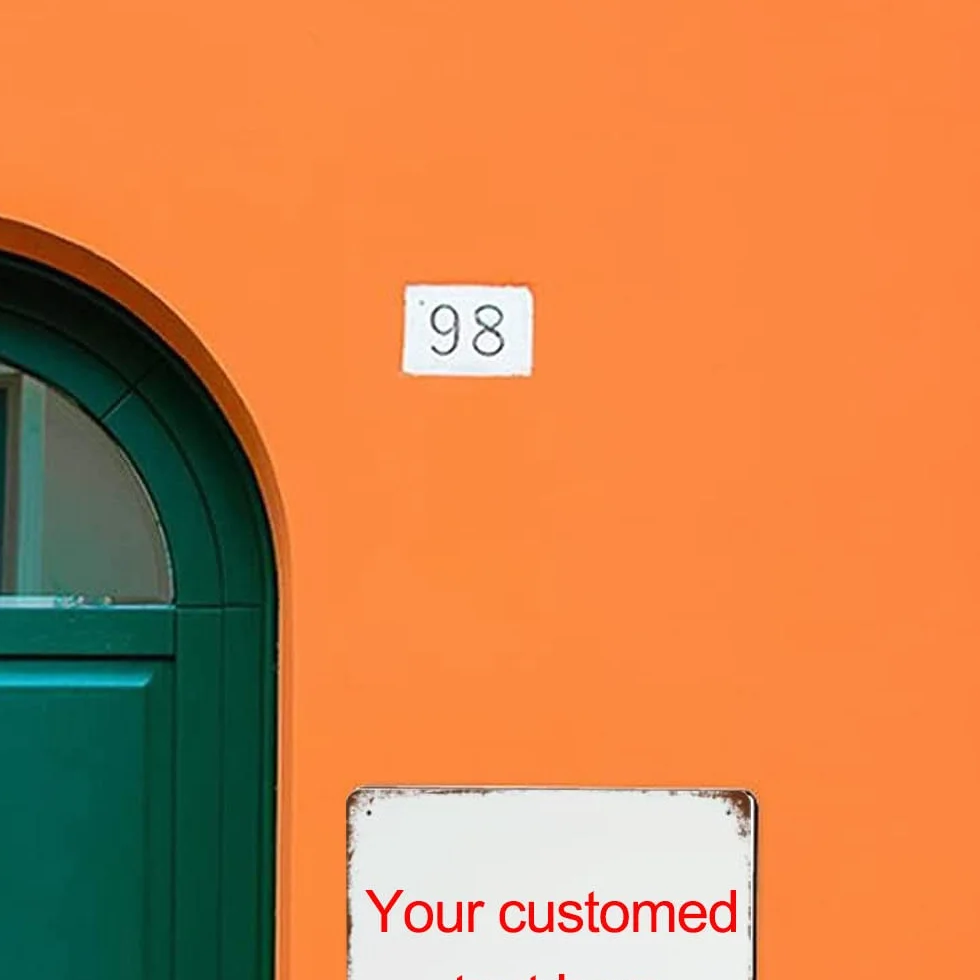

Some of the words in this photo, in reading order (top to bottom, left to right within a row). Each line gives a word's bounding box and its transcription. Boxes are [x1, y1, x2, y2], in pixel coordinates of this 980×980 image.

[430, 304, 504, 356] 98
[365, 889, 484, 933] Your
[498, 889, 737, 934] customed
